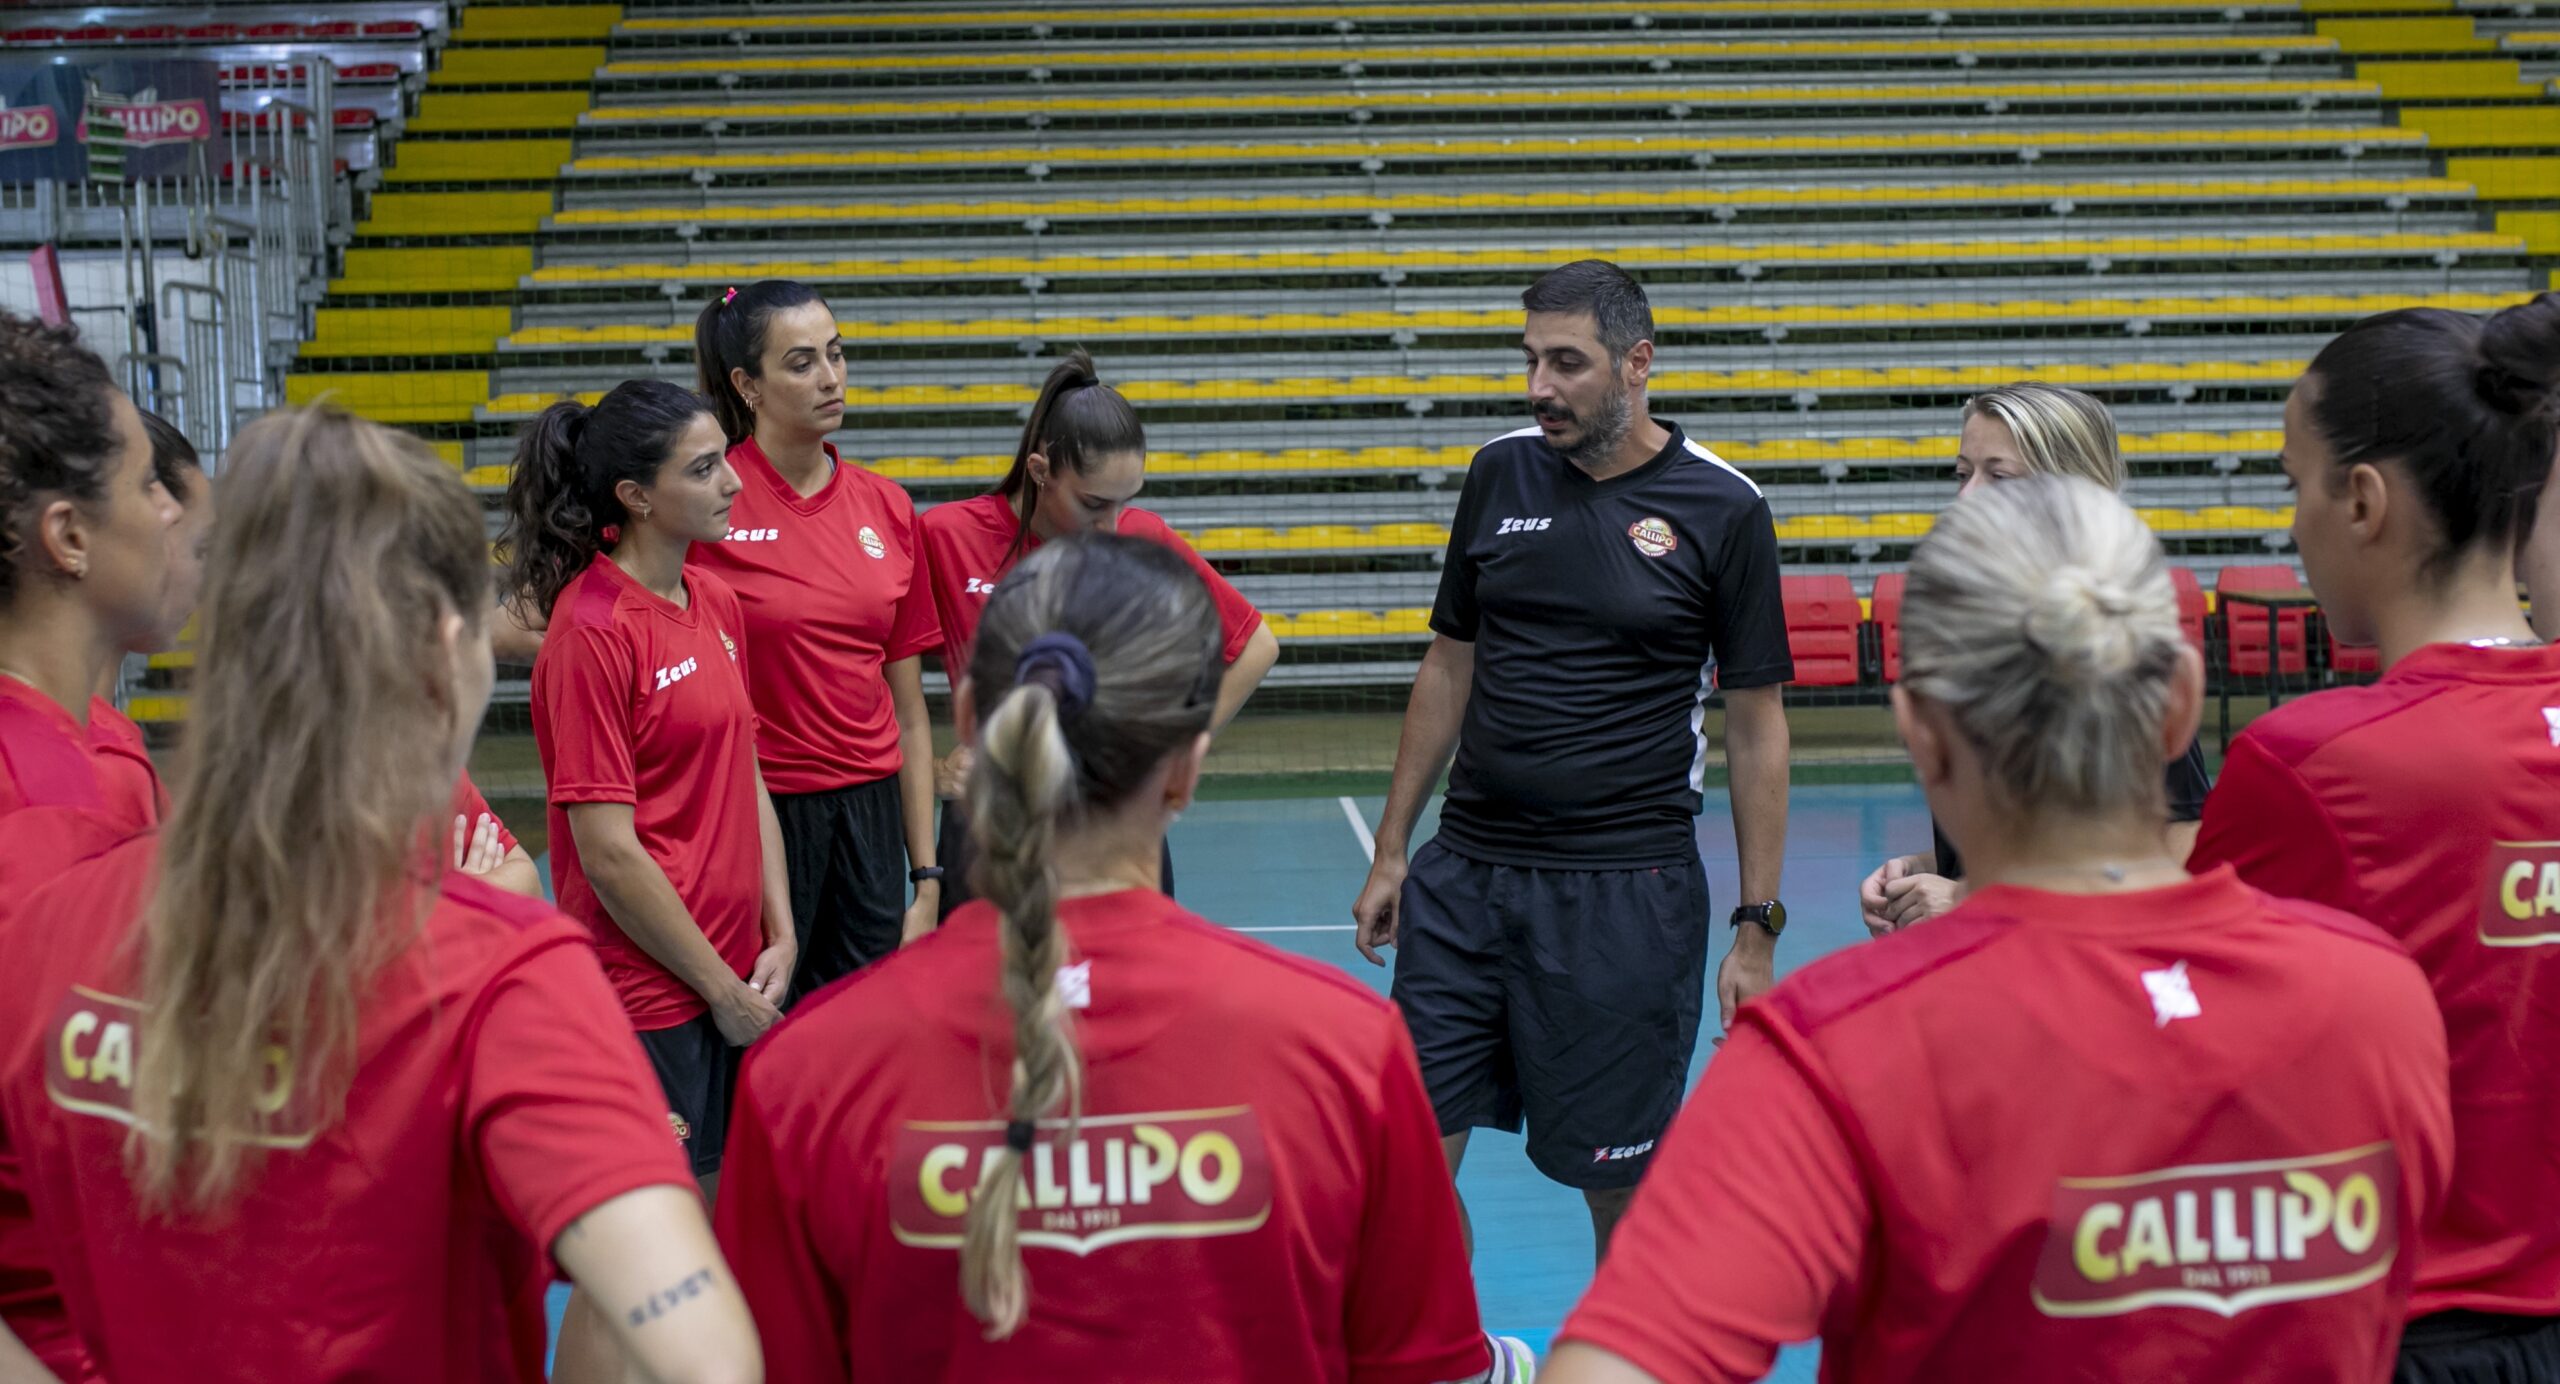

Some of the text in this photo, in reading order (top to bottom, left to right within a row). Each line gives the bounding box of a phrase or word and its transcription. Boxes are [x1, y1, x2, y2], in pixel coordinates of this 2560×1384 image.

[110, 105, 200, 133] ALLIPO
[1496, 517, 1552, 535] Zeus
[1633, 526, 1674, 547] CALLIPO
[965, 577, 995, 594] Ze
[656, 656, 697, 691] Zeus
[2073, 1170, 2380, 1282] CALLIPO
